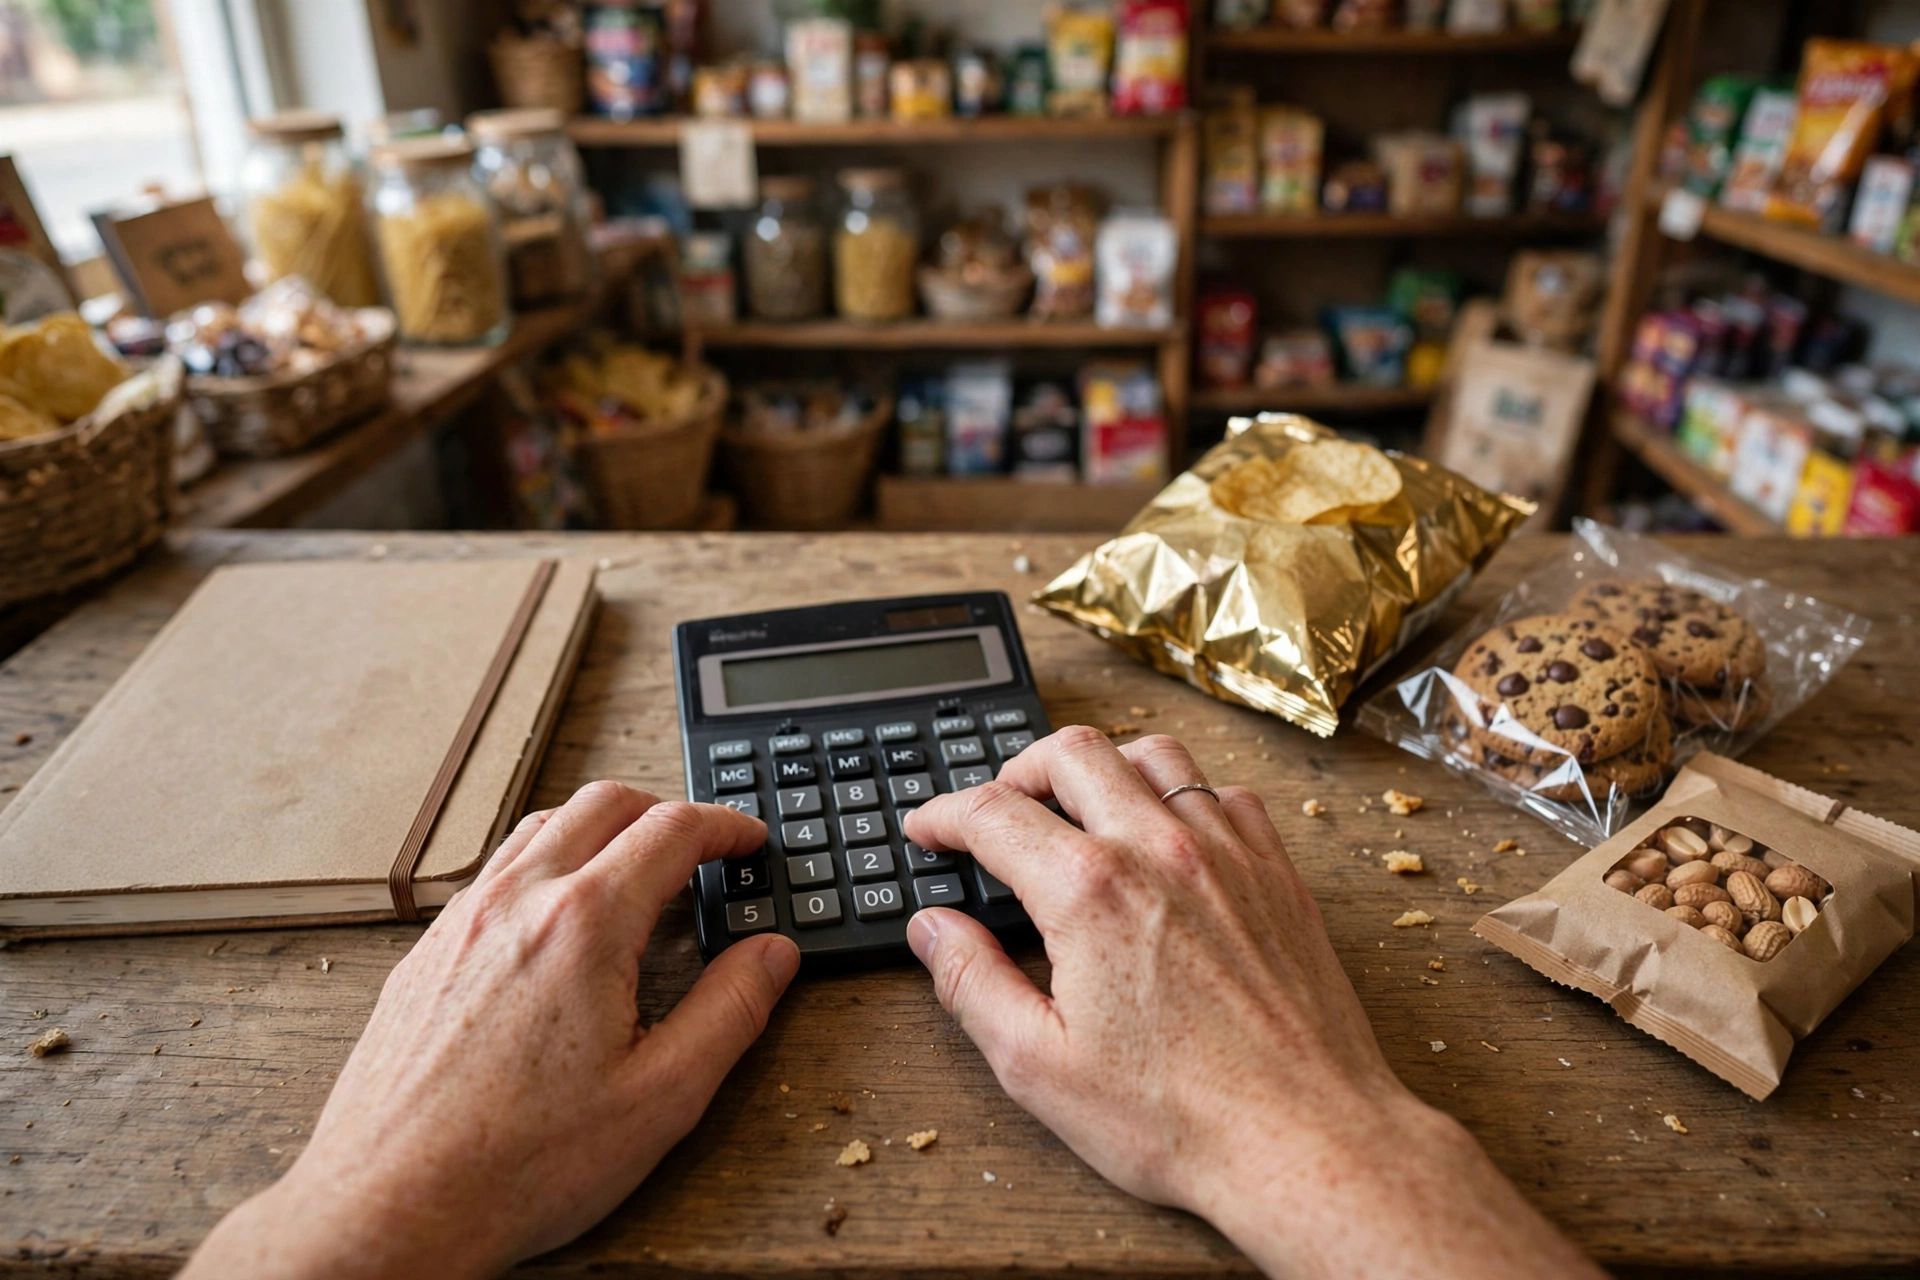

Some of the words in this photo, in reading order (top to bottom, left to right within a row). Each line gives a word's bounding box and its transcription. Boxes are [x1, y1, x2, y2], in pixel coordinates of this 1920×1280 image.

[720, 768, 747, 782] MC
[849, 786, 864, 800] 8
[904, 779, 920, 794] 9
[791, 792, 806, 808] 7
[797, 825, 813, 841] 4
[856, 817, 871, 834] 5
[804, 860, 816, 877] 1
[863, 853, 879, 870] 2
[740, 868, 754, 886] 5
[809, 897, 824, 914] 0
[864, 888, 894, 907] 00
[744, 905, 759, 923] 5
